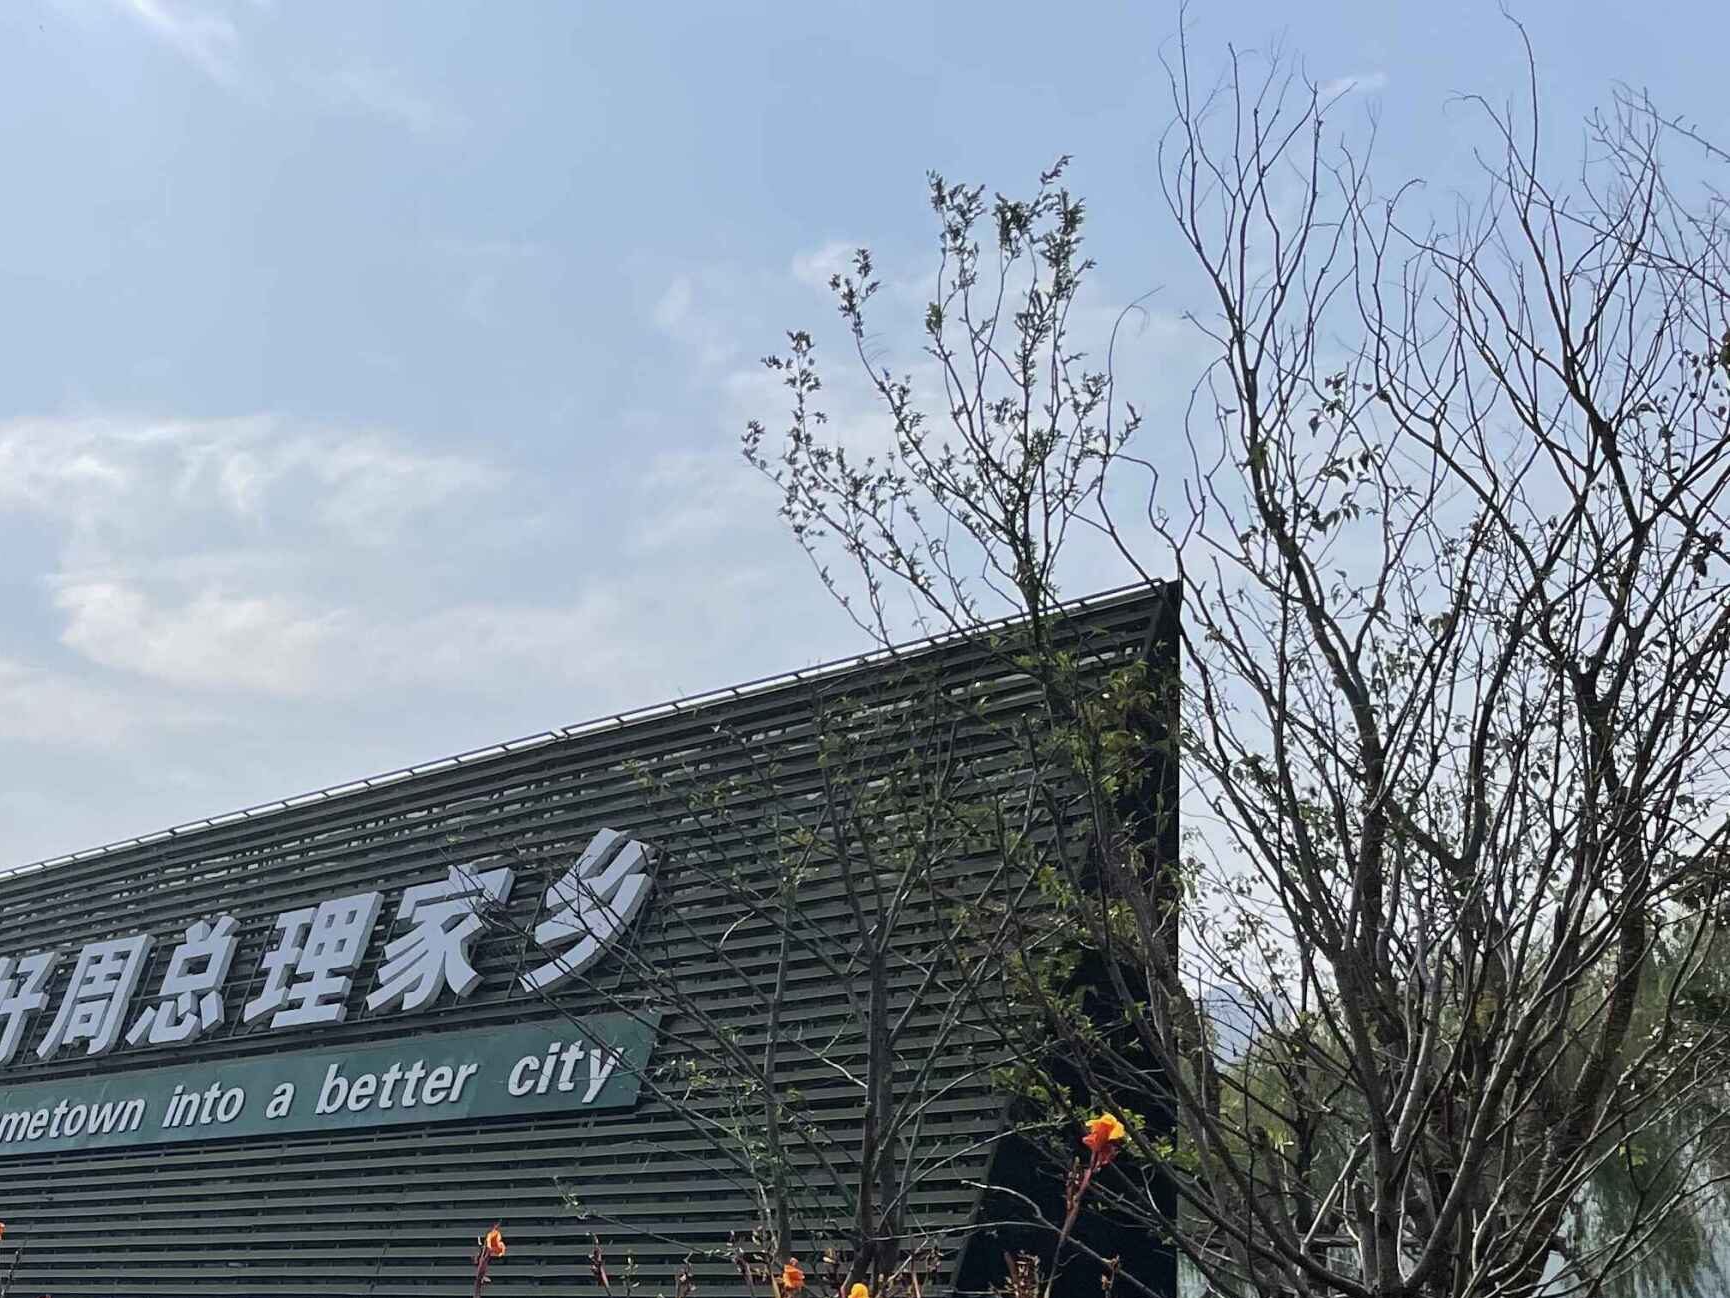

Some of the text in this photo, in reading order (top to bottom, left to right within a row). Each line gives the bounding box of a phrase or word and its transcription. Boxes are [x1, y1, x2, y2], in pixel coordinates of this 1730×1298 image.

[164, 1083, 244, 1127] into
[265, 1079, 295, 1118] a
[316, 1059, 478, 1114] better
[507, 1039, 626, 1104] city
